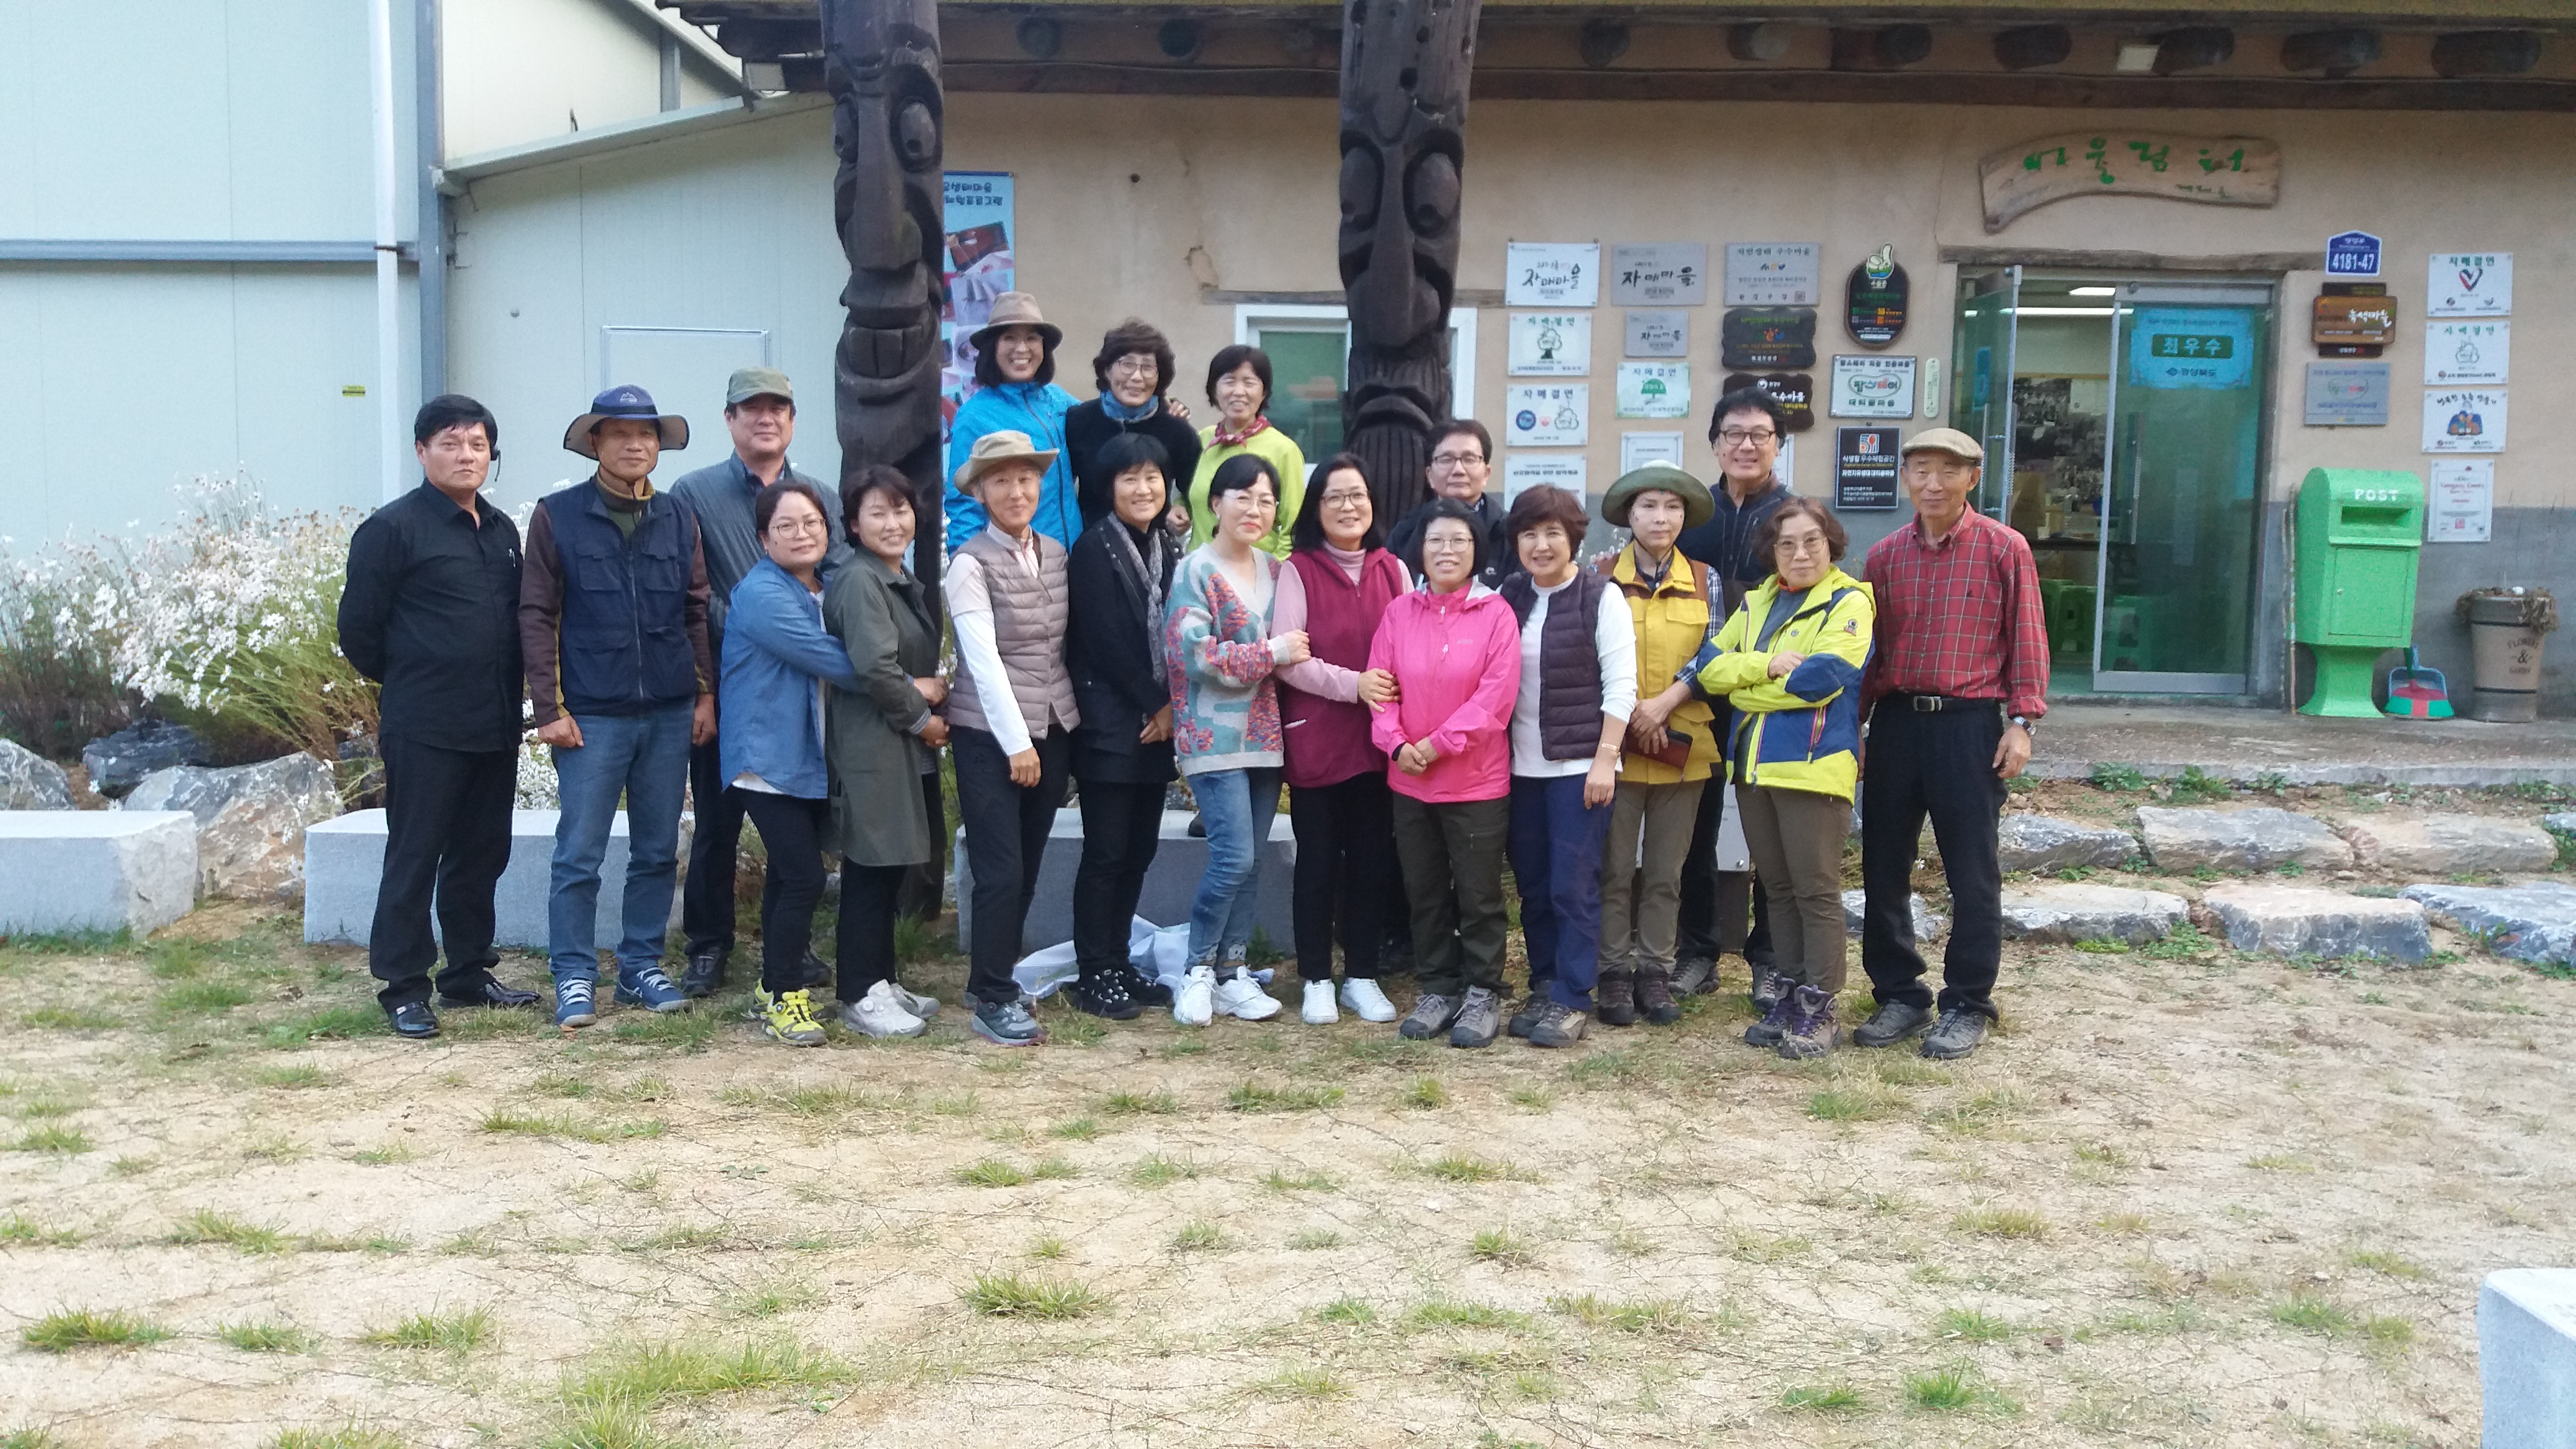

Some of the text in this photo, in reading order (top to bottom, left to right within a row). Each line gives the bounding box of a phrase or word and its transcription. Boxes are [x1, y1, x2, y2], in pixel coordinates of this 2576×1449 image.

[2332, 253, 2374, 270] 4181-47
[2449, 256, 2495, 266] 자매결연
[1523, 263, 1581, 289] 자매마을
[2163, 337, 2222, 356] 최우수
[2355, 489, 2399, 501] POST
[2518, 650, 2529, 663] &
